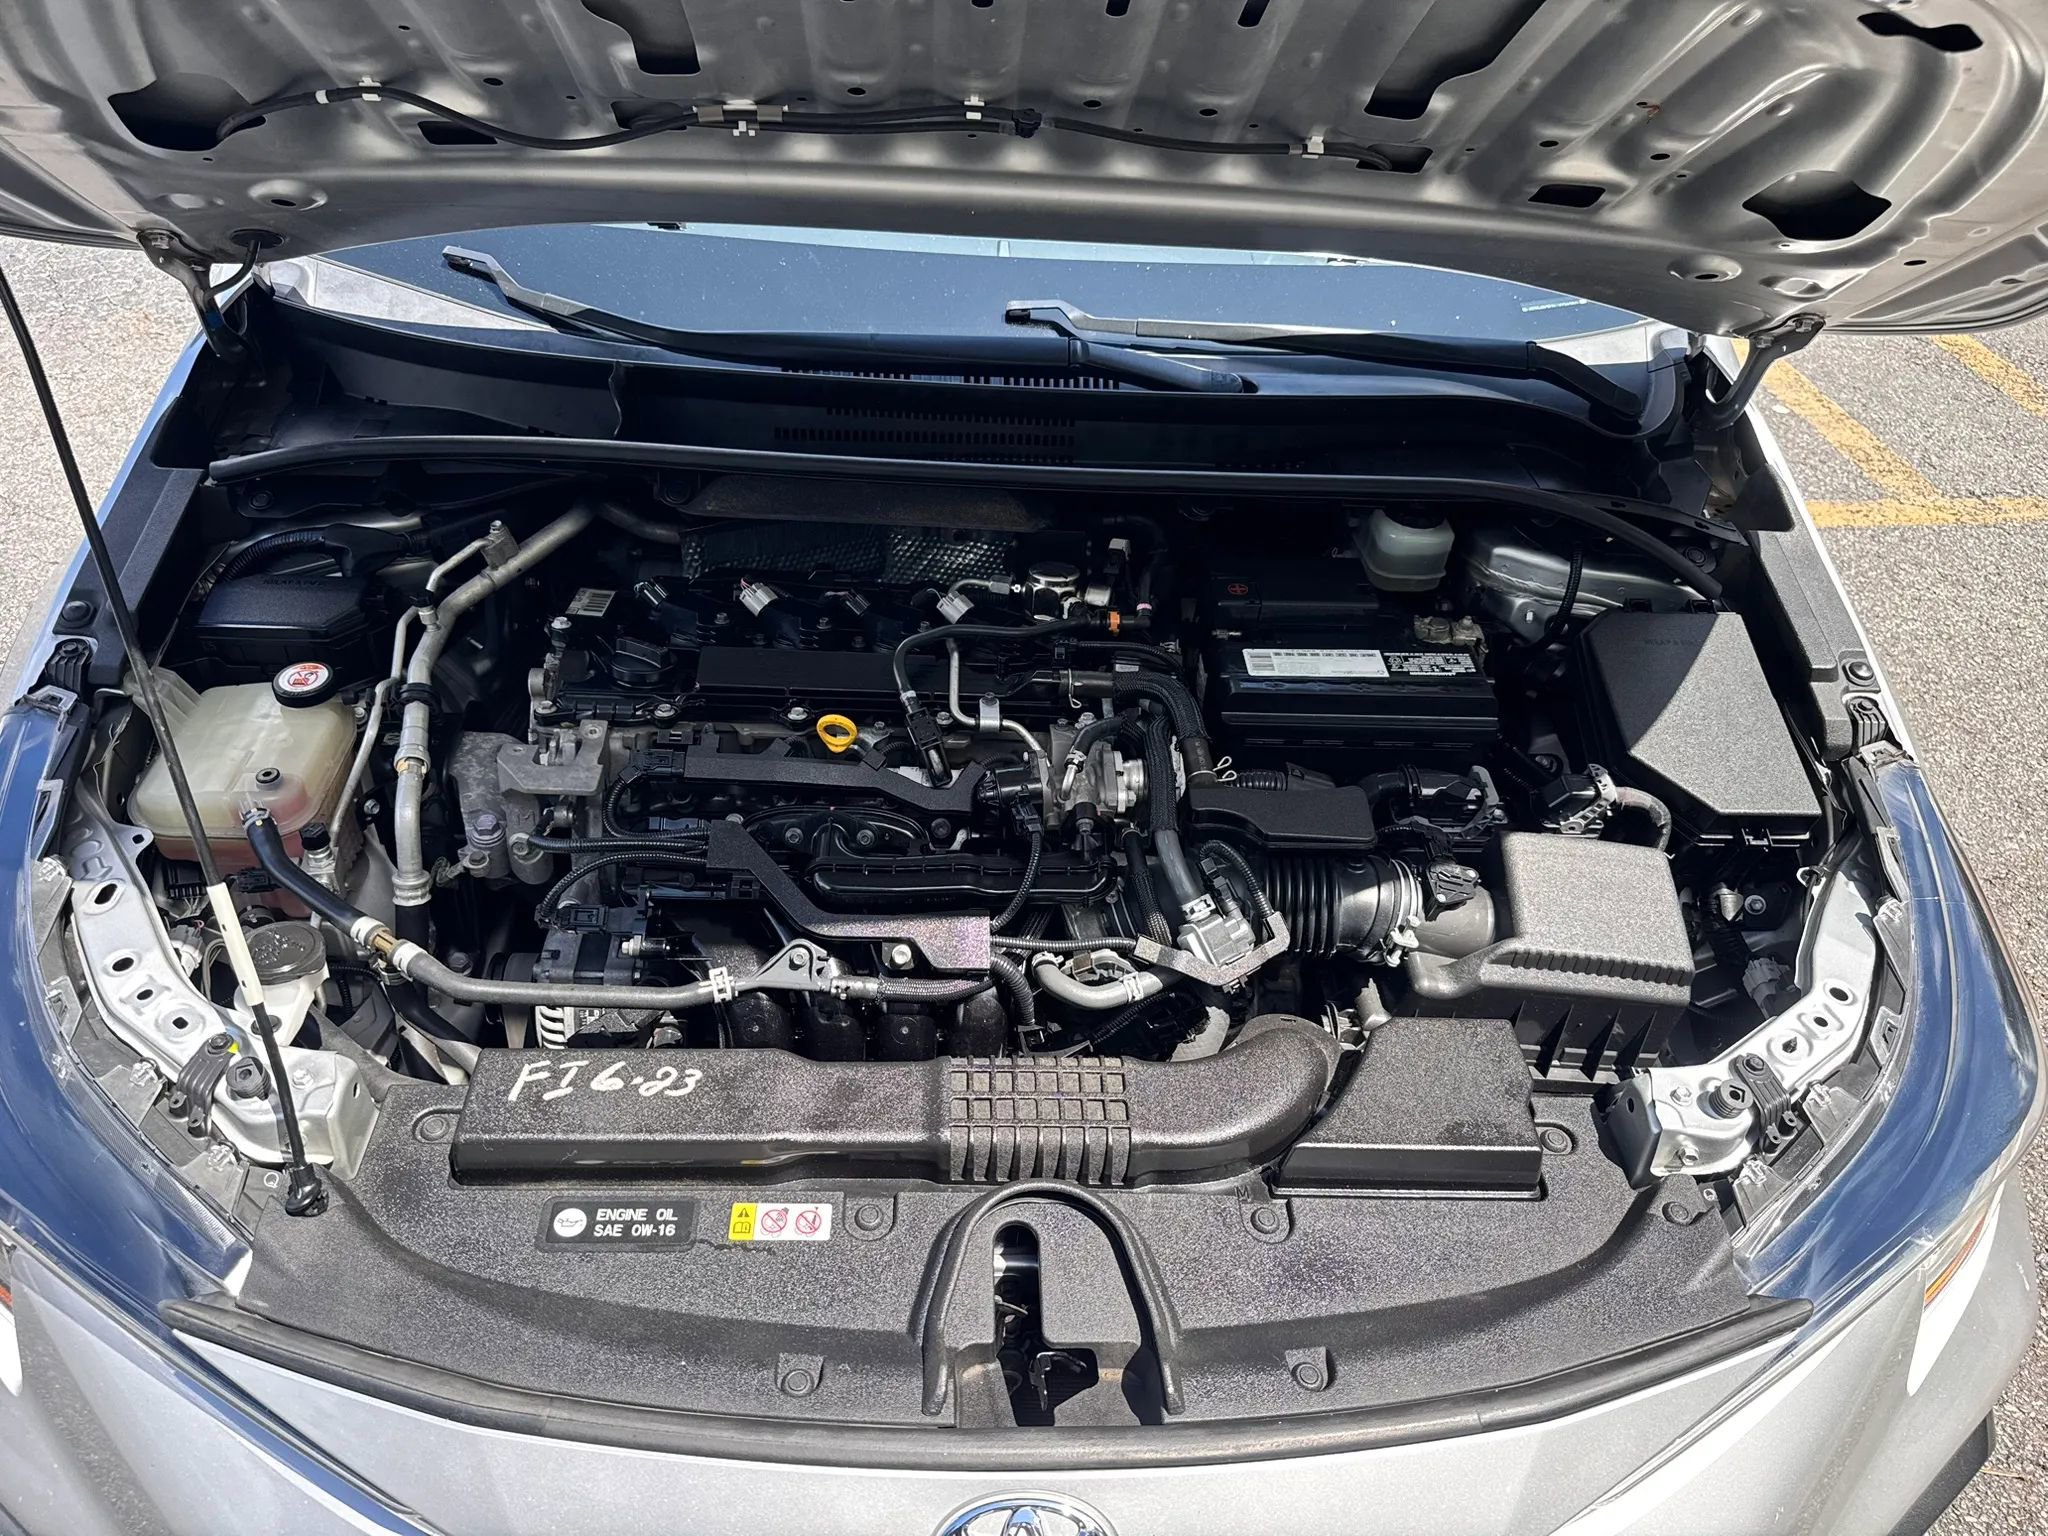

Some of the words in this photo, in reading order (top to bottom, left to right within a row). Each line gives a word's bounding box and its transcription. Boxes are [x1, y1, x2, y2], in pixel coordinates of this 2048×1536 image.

[595, 1208, 649, 1221] ENGINE
[655, 1208, 678, 1221] OIL
[593, 1224, 624, 1237] SAE
[631, 1224, 676, 1237] 0W-16
